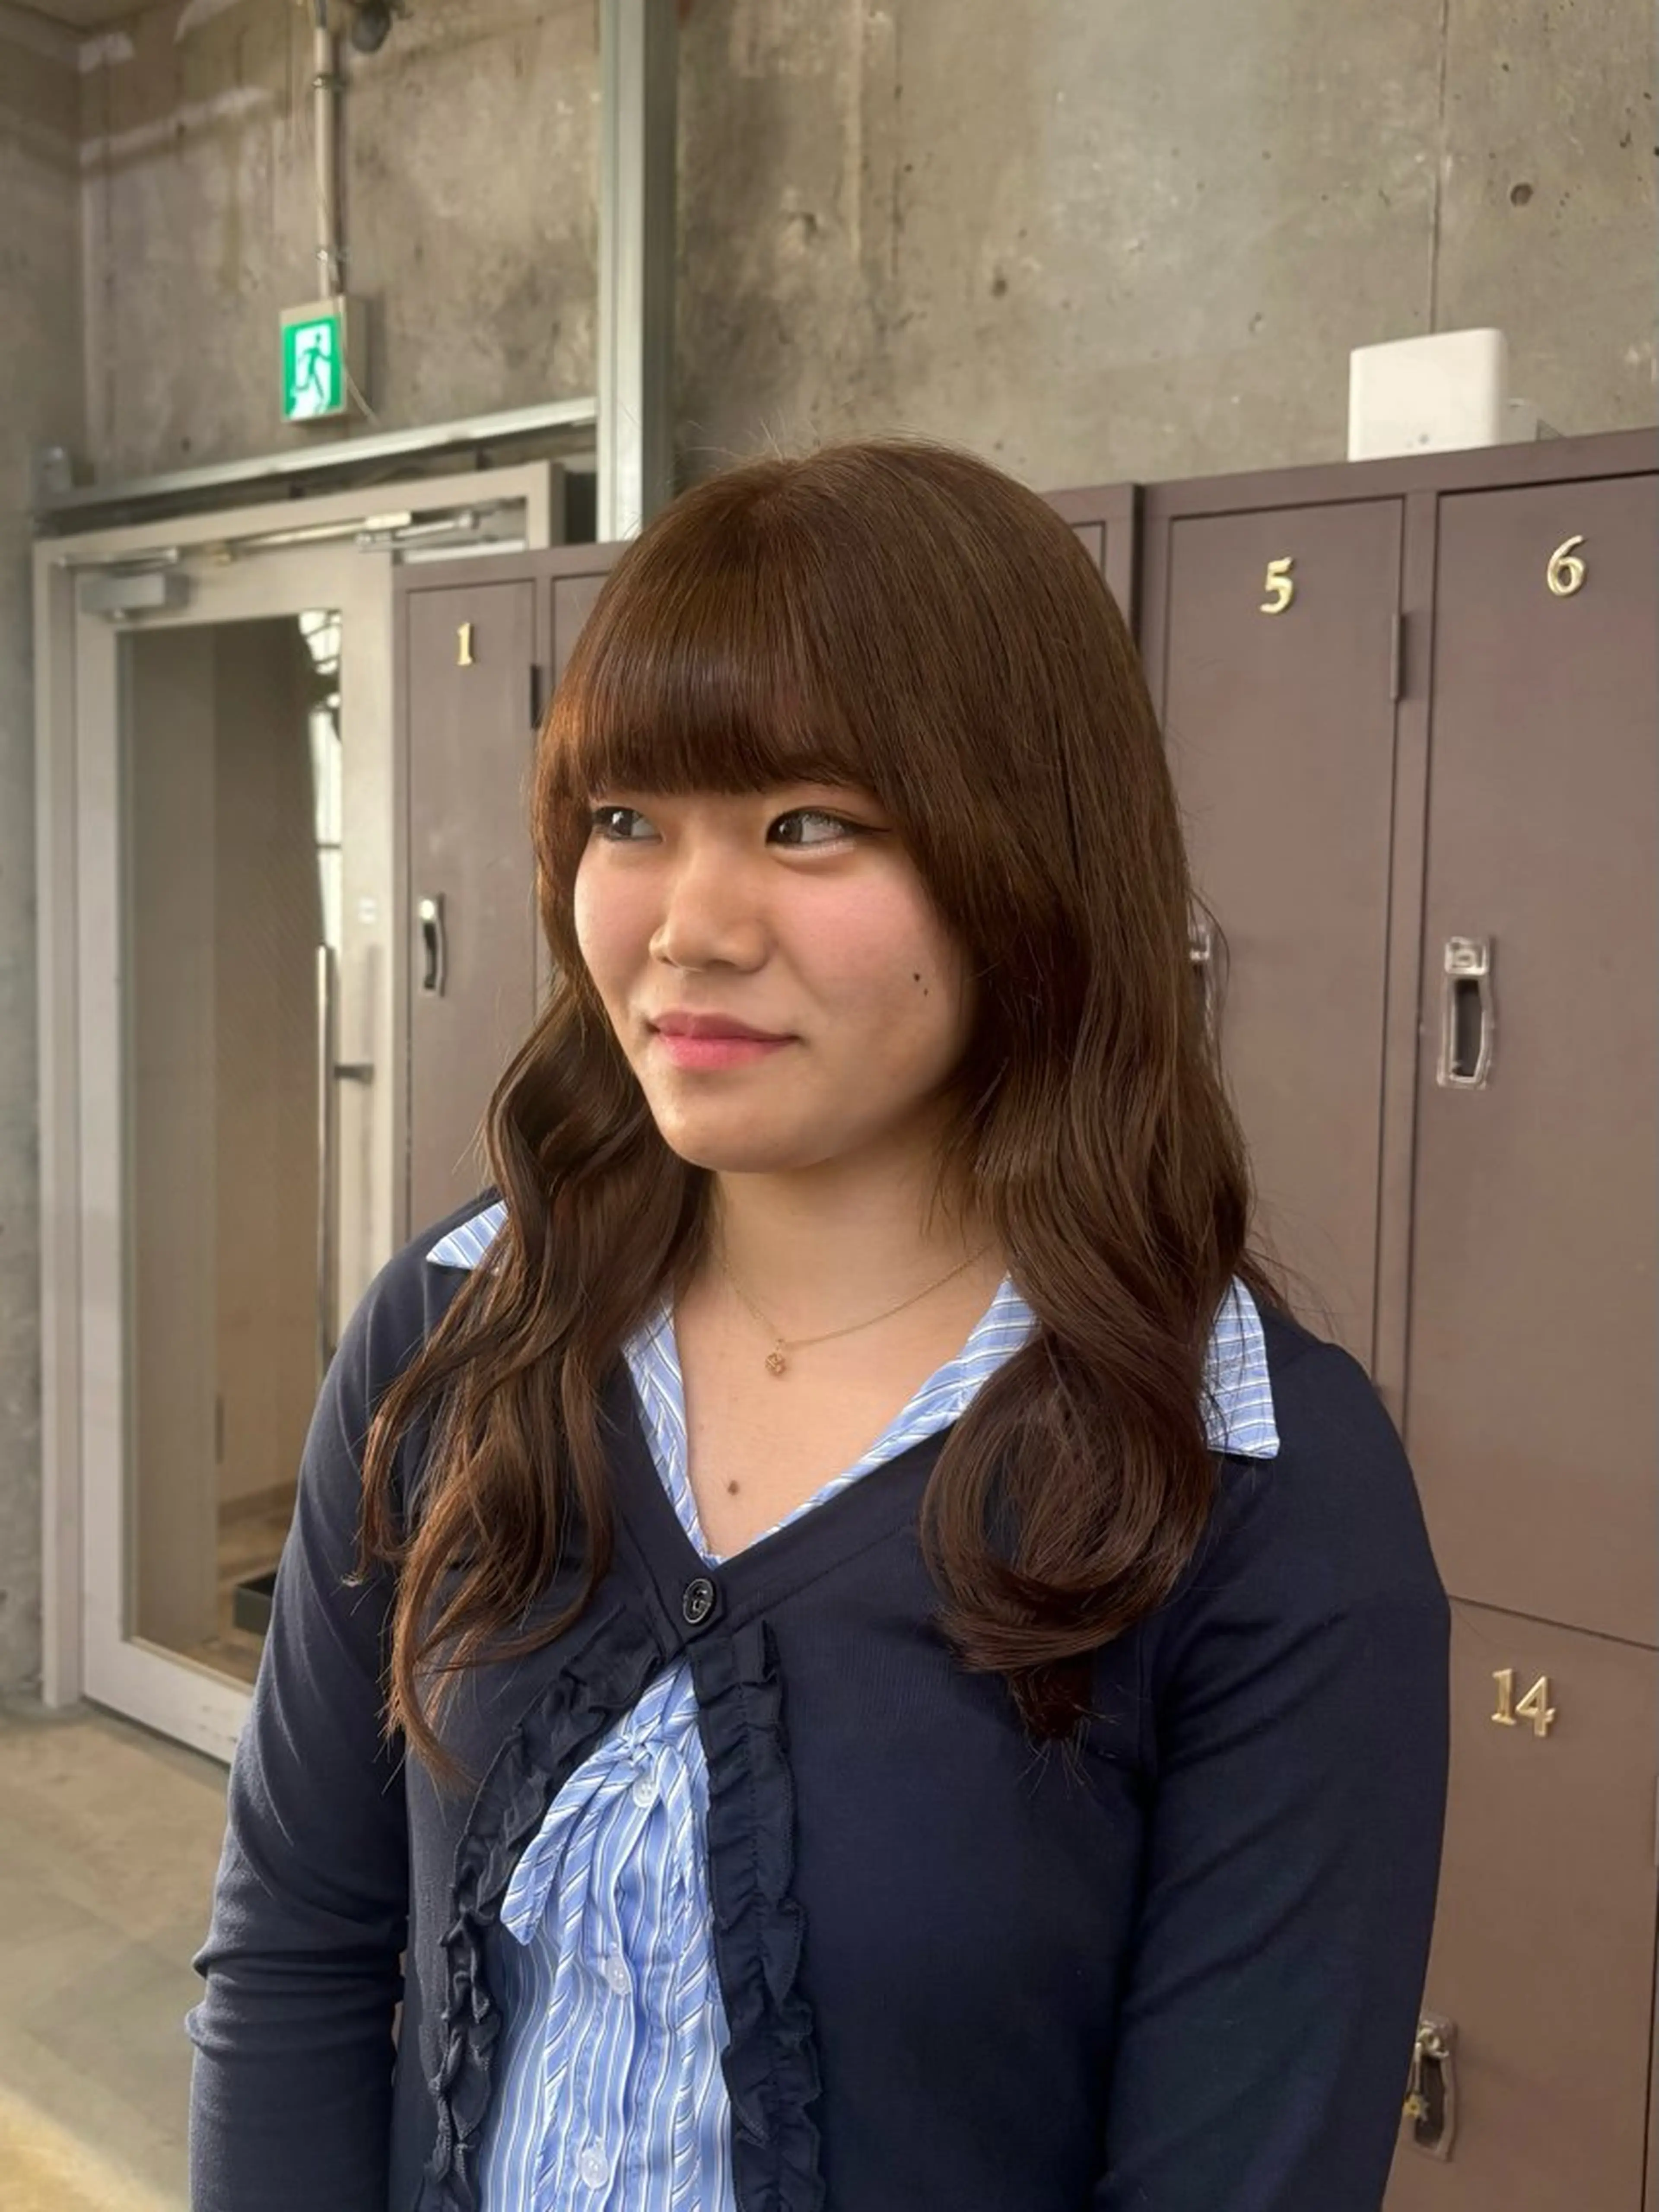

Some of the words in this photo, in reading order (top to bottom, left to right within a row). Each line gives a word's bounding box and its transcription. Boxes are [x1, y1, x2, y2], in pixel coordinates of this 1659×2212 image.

[1260, 557, 1294, 614] 5
[1546, 535, 1586, 597] 6
[457, 623, 474, 666] 1
[1491, 1669, 1555, 1736] 14
